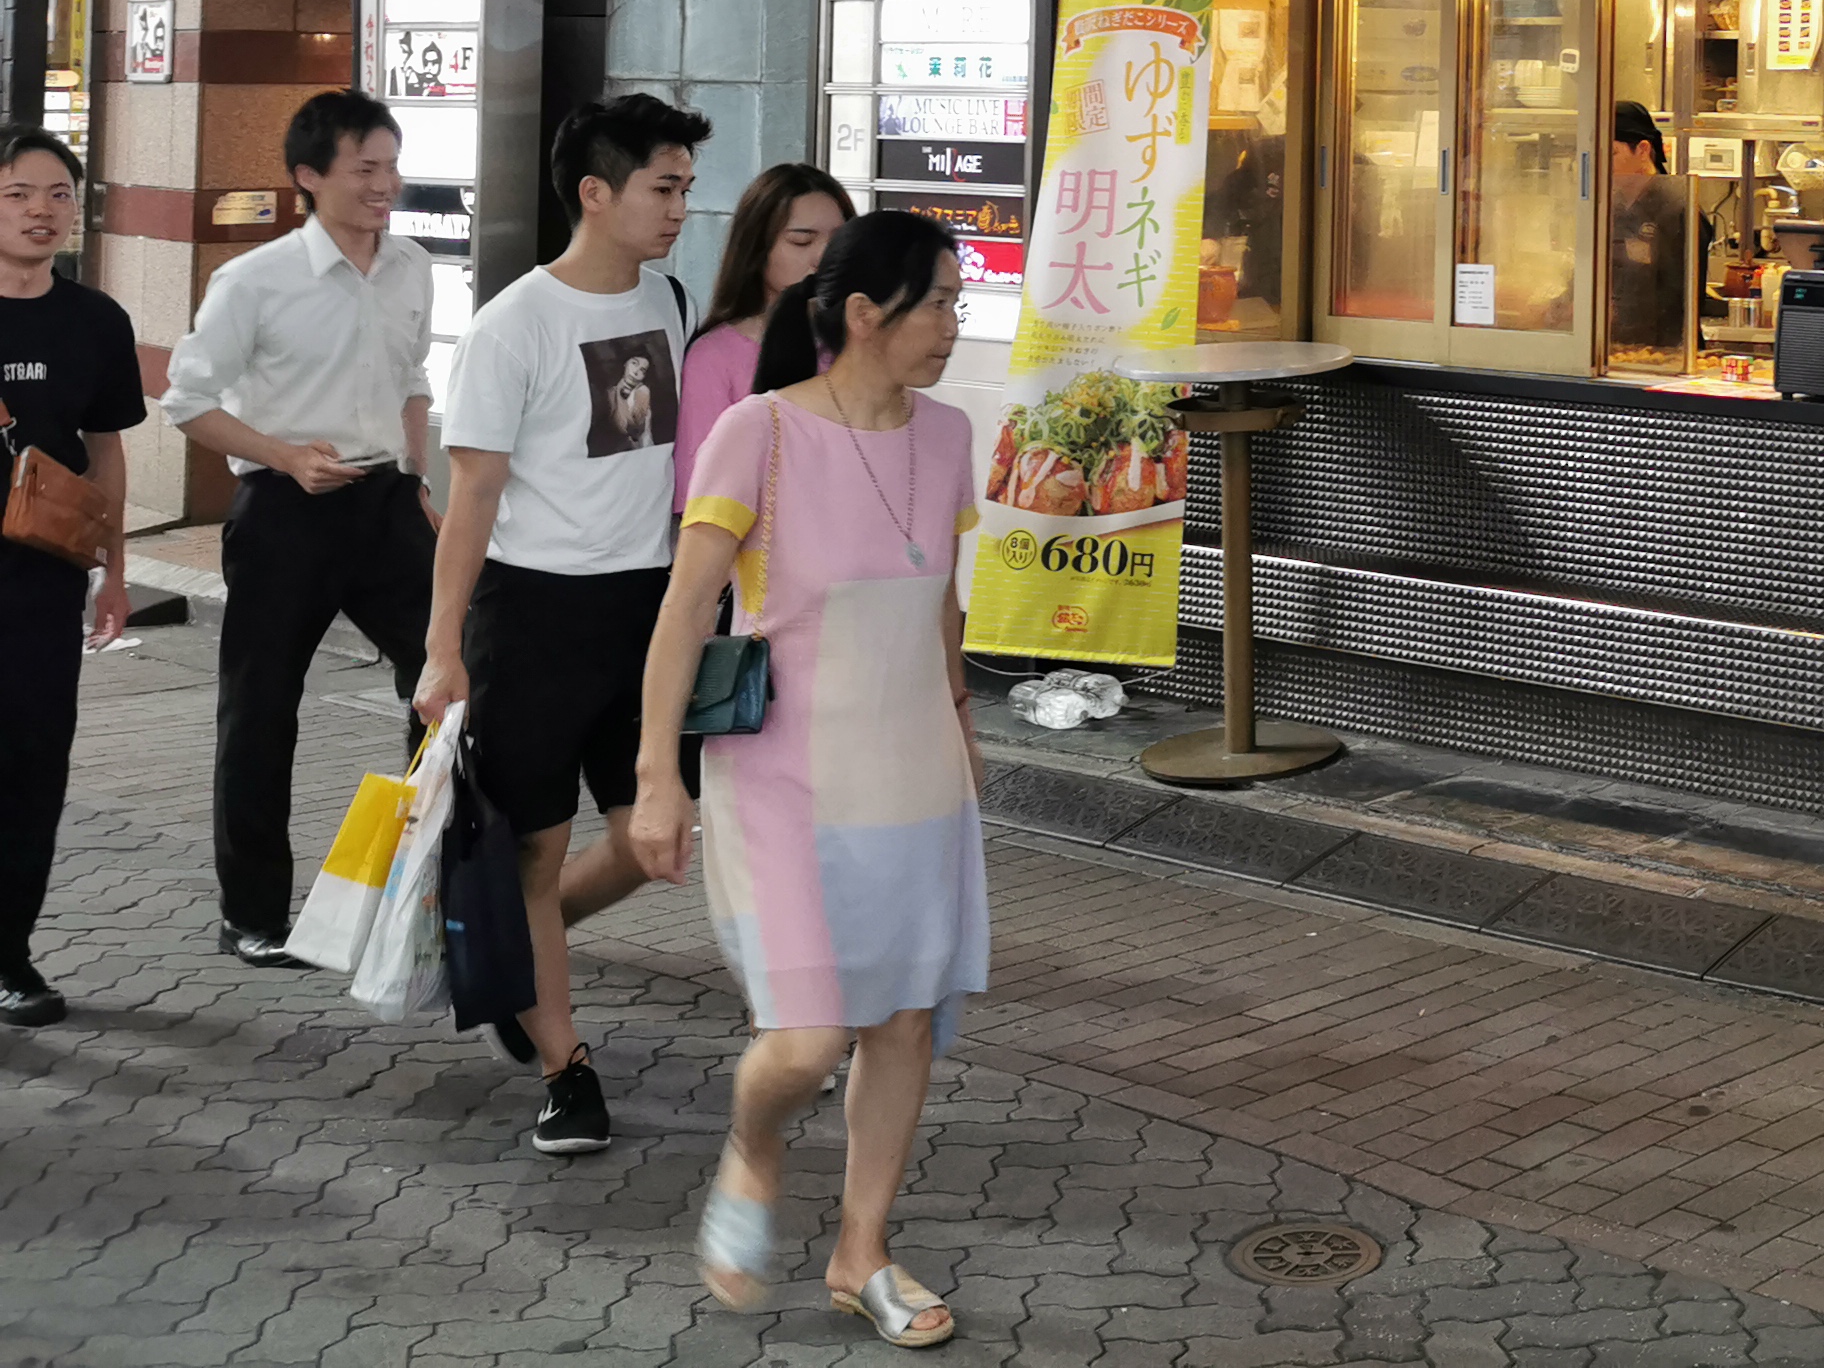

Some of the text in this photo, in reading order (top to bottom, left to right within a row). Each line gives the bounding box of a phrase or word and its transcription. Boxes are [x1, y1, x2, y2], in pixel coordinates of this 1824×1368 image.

[449, 47, 473, 73] 4F
[837, 123, 866, 151] 2F
[969, 118, 999, 135] BAR
[1041, 168, 1118, 316] 明太
[1041, 534, 1155, 578] 680円
